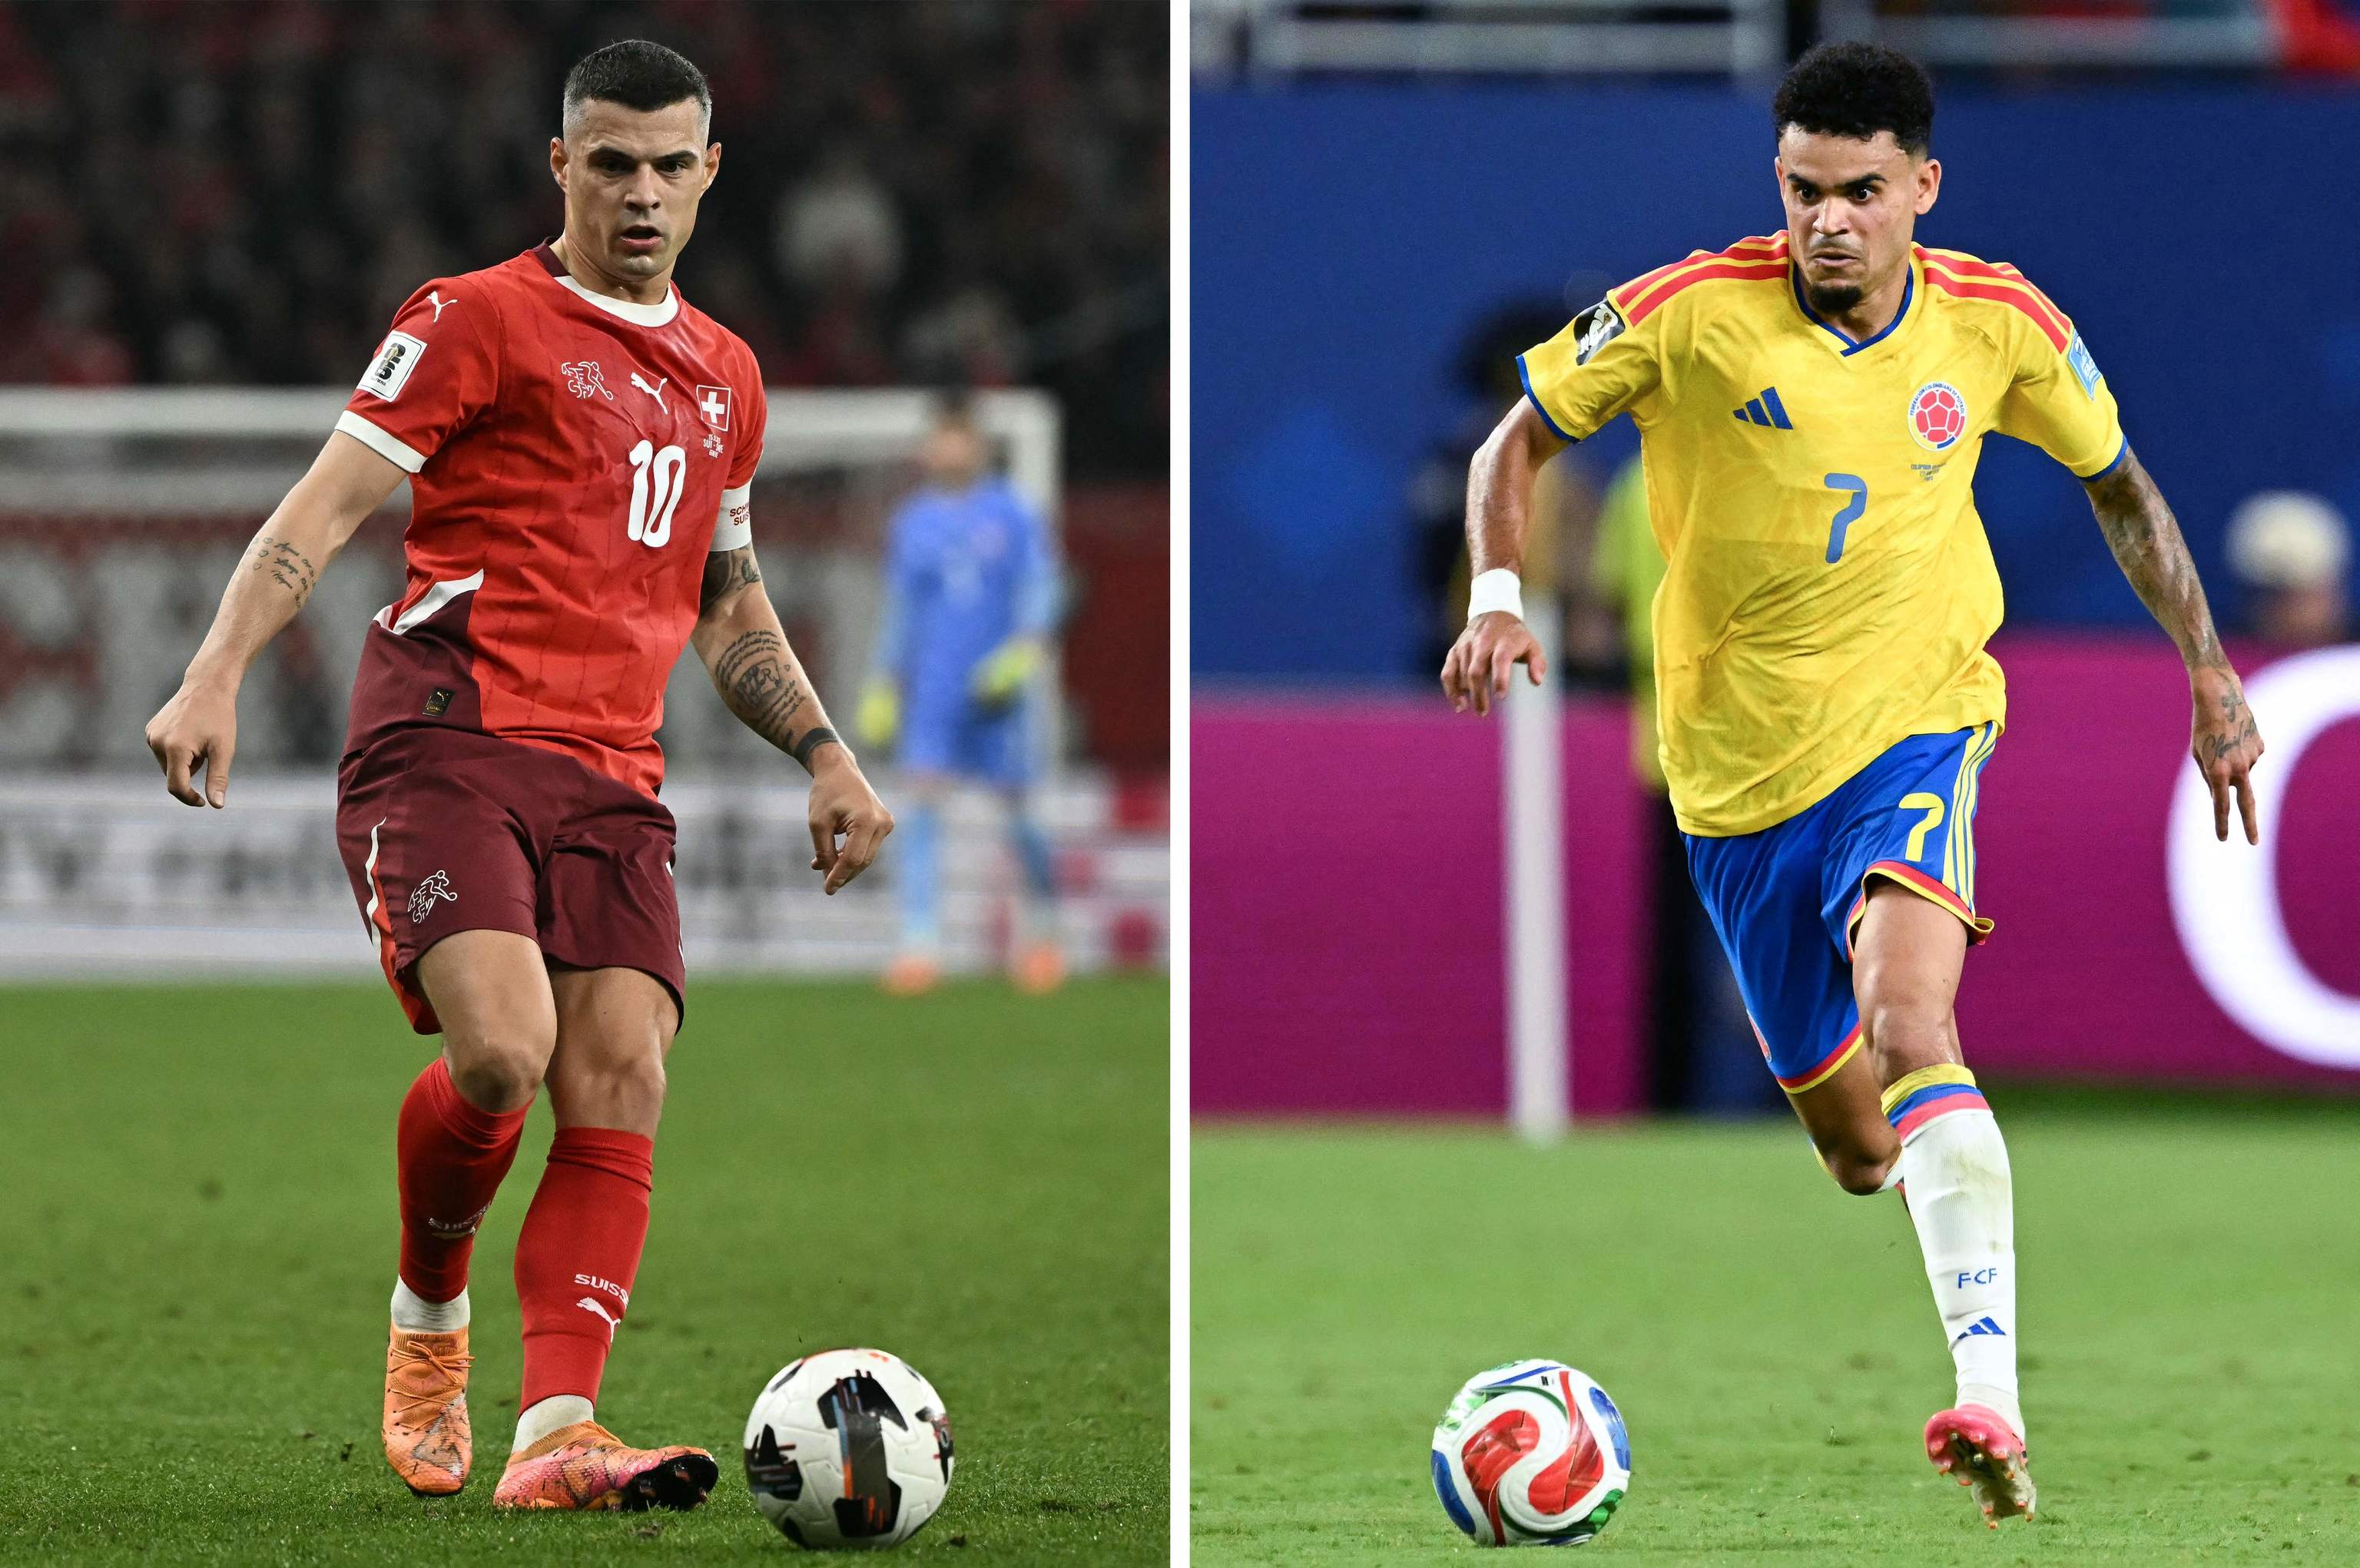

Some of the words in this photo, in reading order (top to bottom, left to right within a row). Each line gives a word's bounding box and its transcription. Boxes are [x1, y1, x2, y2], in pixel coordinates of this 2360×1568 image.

[627, 439, 687, 549] 10
[1824, 472, 1868, 564] 7
[1898, 791, 1945, 863] 7
[1958, 1268, 1998, 1289] FCF
